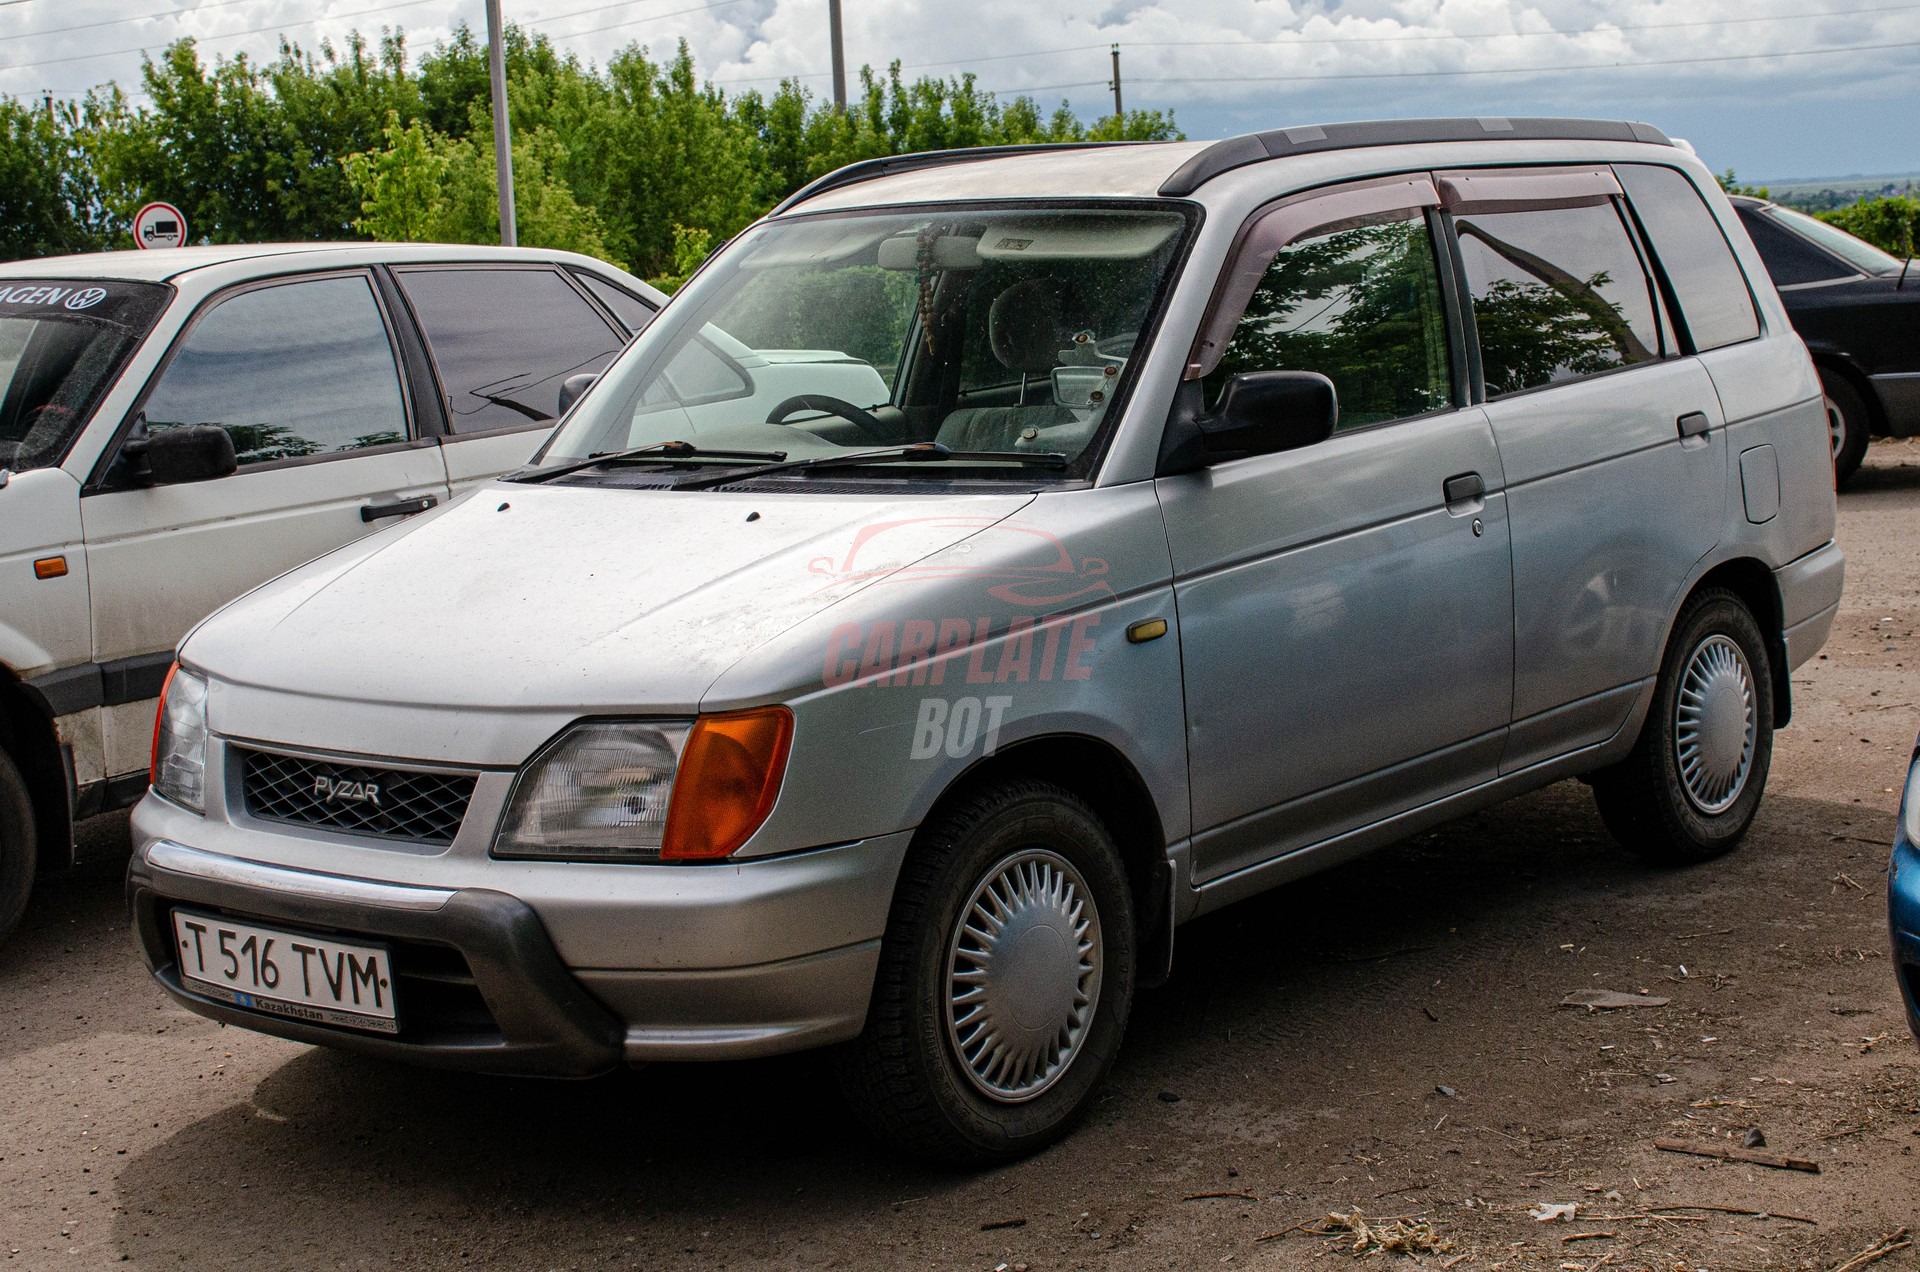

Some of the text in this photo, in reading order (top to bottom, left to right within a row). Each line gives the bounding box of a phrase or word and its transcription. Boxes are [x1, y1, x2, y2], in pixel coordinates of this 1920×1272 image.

[185, 920, 383, 1009] T 516 TVM
[255, 998, 323, 1020] Kazakhstan
